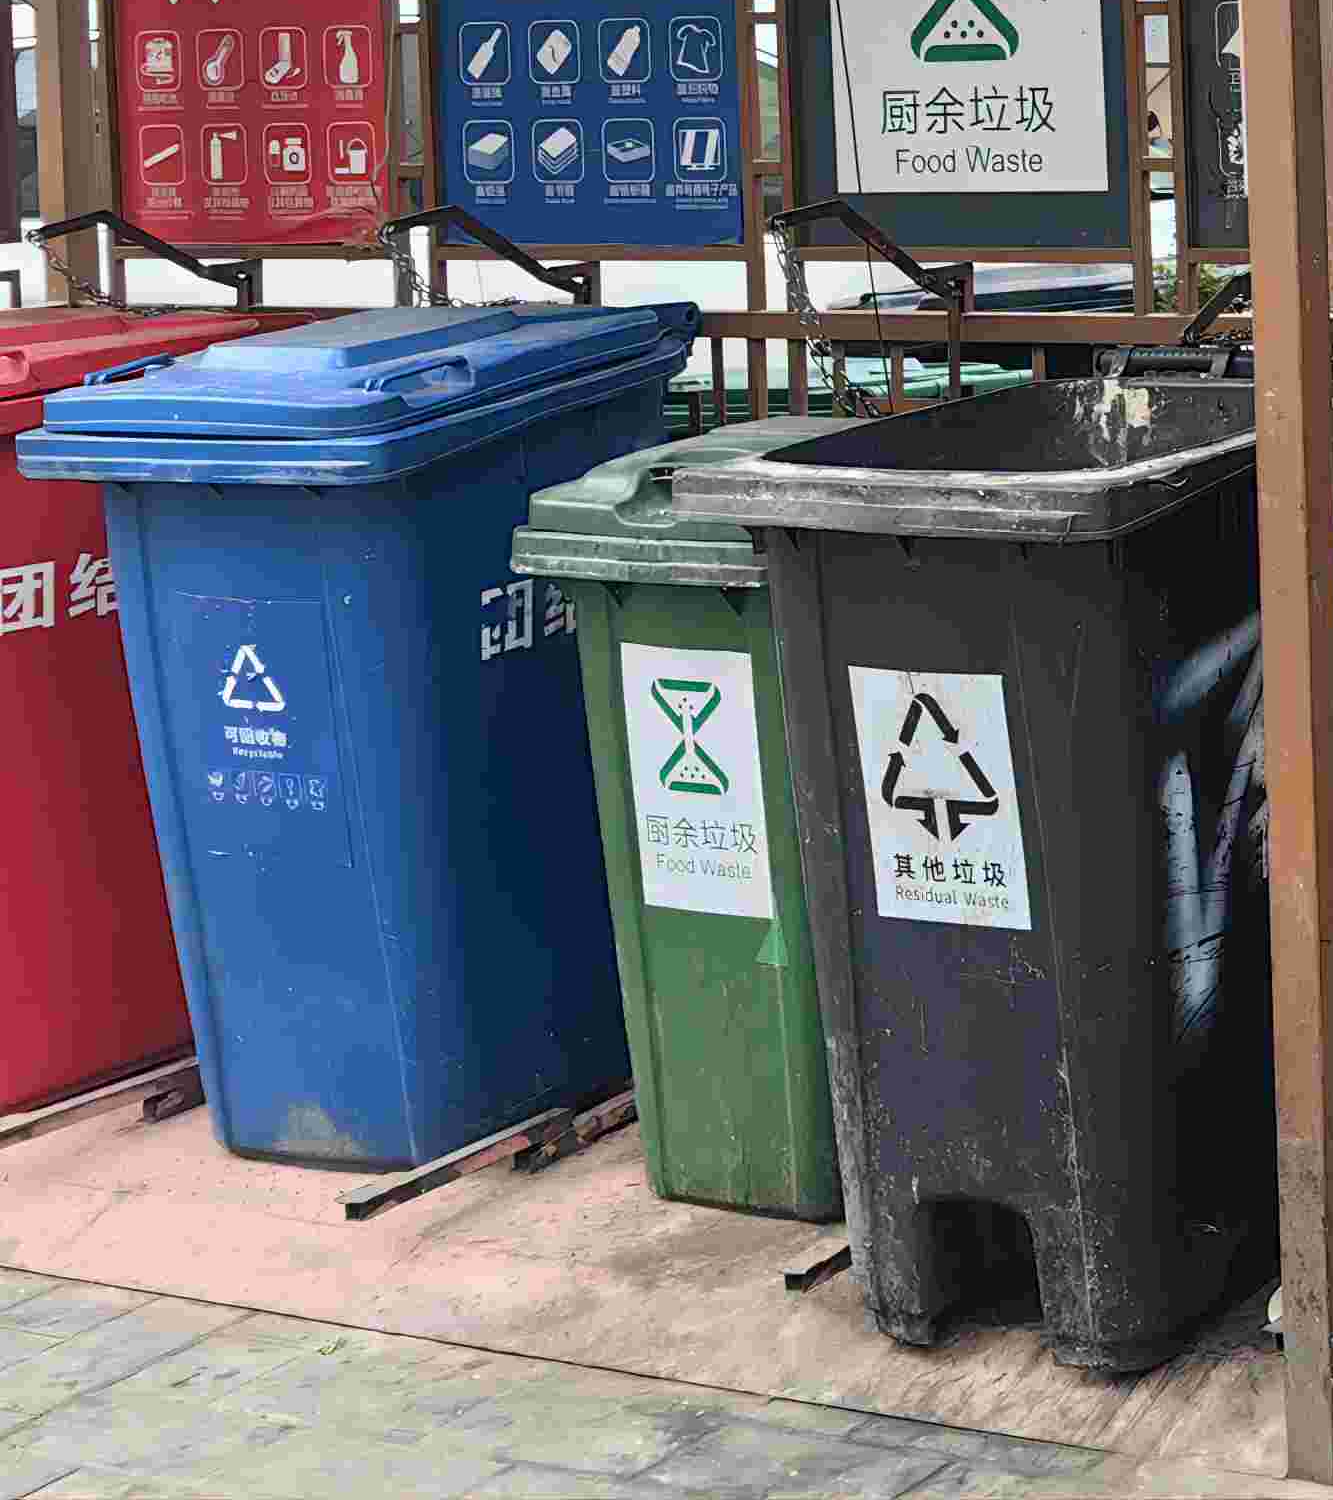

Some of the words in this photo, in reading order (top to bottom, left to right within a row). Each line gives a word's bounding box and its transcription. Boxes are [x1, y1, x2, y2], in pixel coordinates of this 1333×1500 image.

[881, 86, 1057, 137] 厨余垃圾
[895, 148, 956, 175] Food
[967, 146, 1044, 174] Waste
[645, 814, 761, 855] 厨余垃圾
[655, 853, 697, 877] Food
[700, 858, 753, 881] Waste
[893, 853, 1008, 889] 其他垃圾
[895, 885, 959, 907] Residual
[964, 890, 1011, 911] Waste
